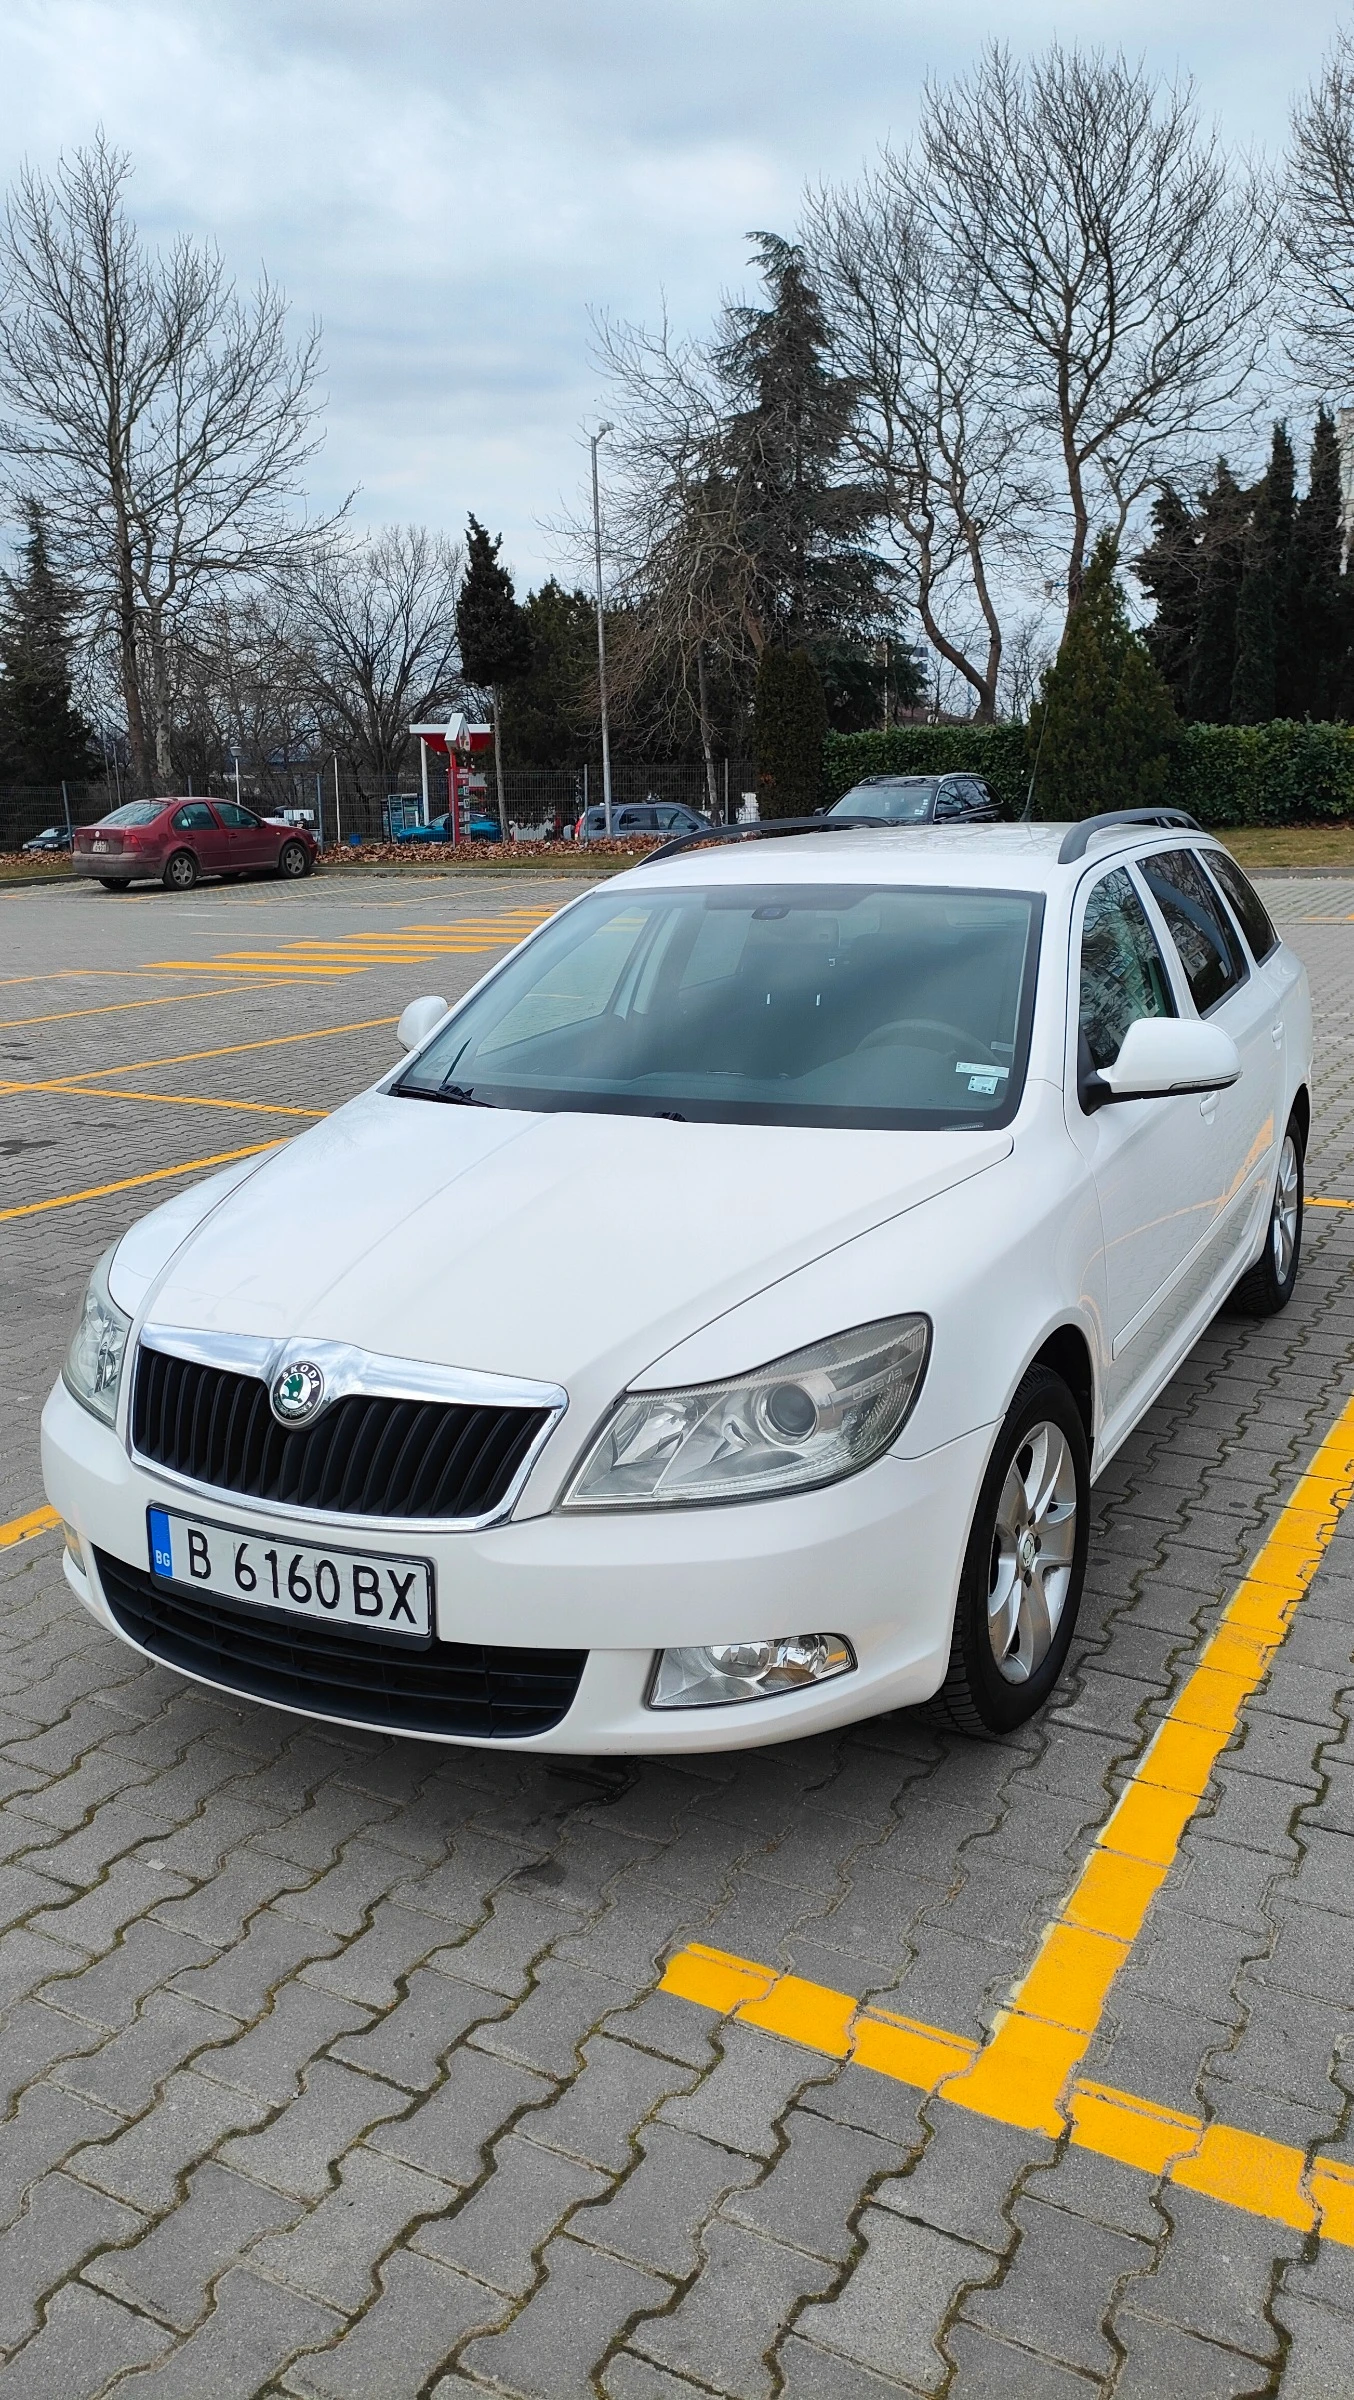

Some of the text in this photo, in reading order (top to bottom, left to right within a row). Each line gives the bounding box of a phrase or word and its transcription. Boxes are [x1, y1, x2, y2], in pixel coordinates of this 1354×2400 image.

[155, 1549, 171, 1567] BG
[187, 1528, 417, 1625] B 6160 BX
